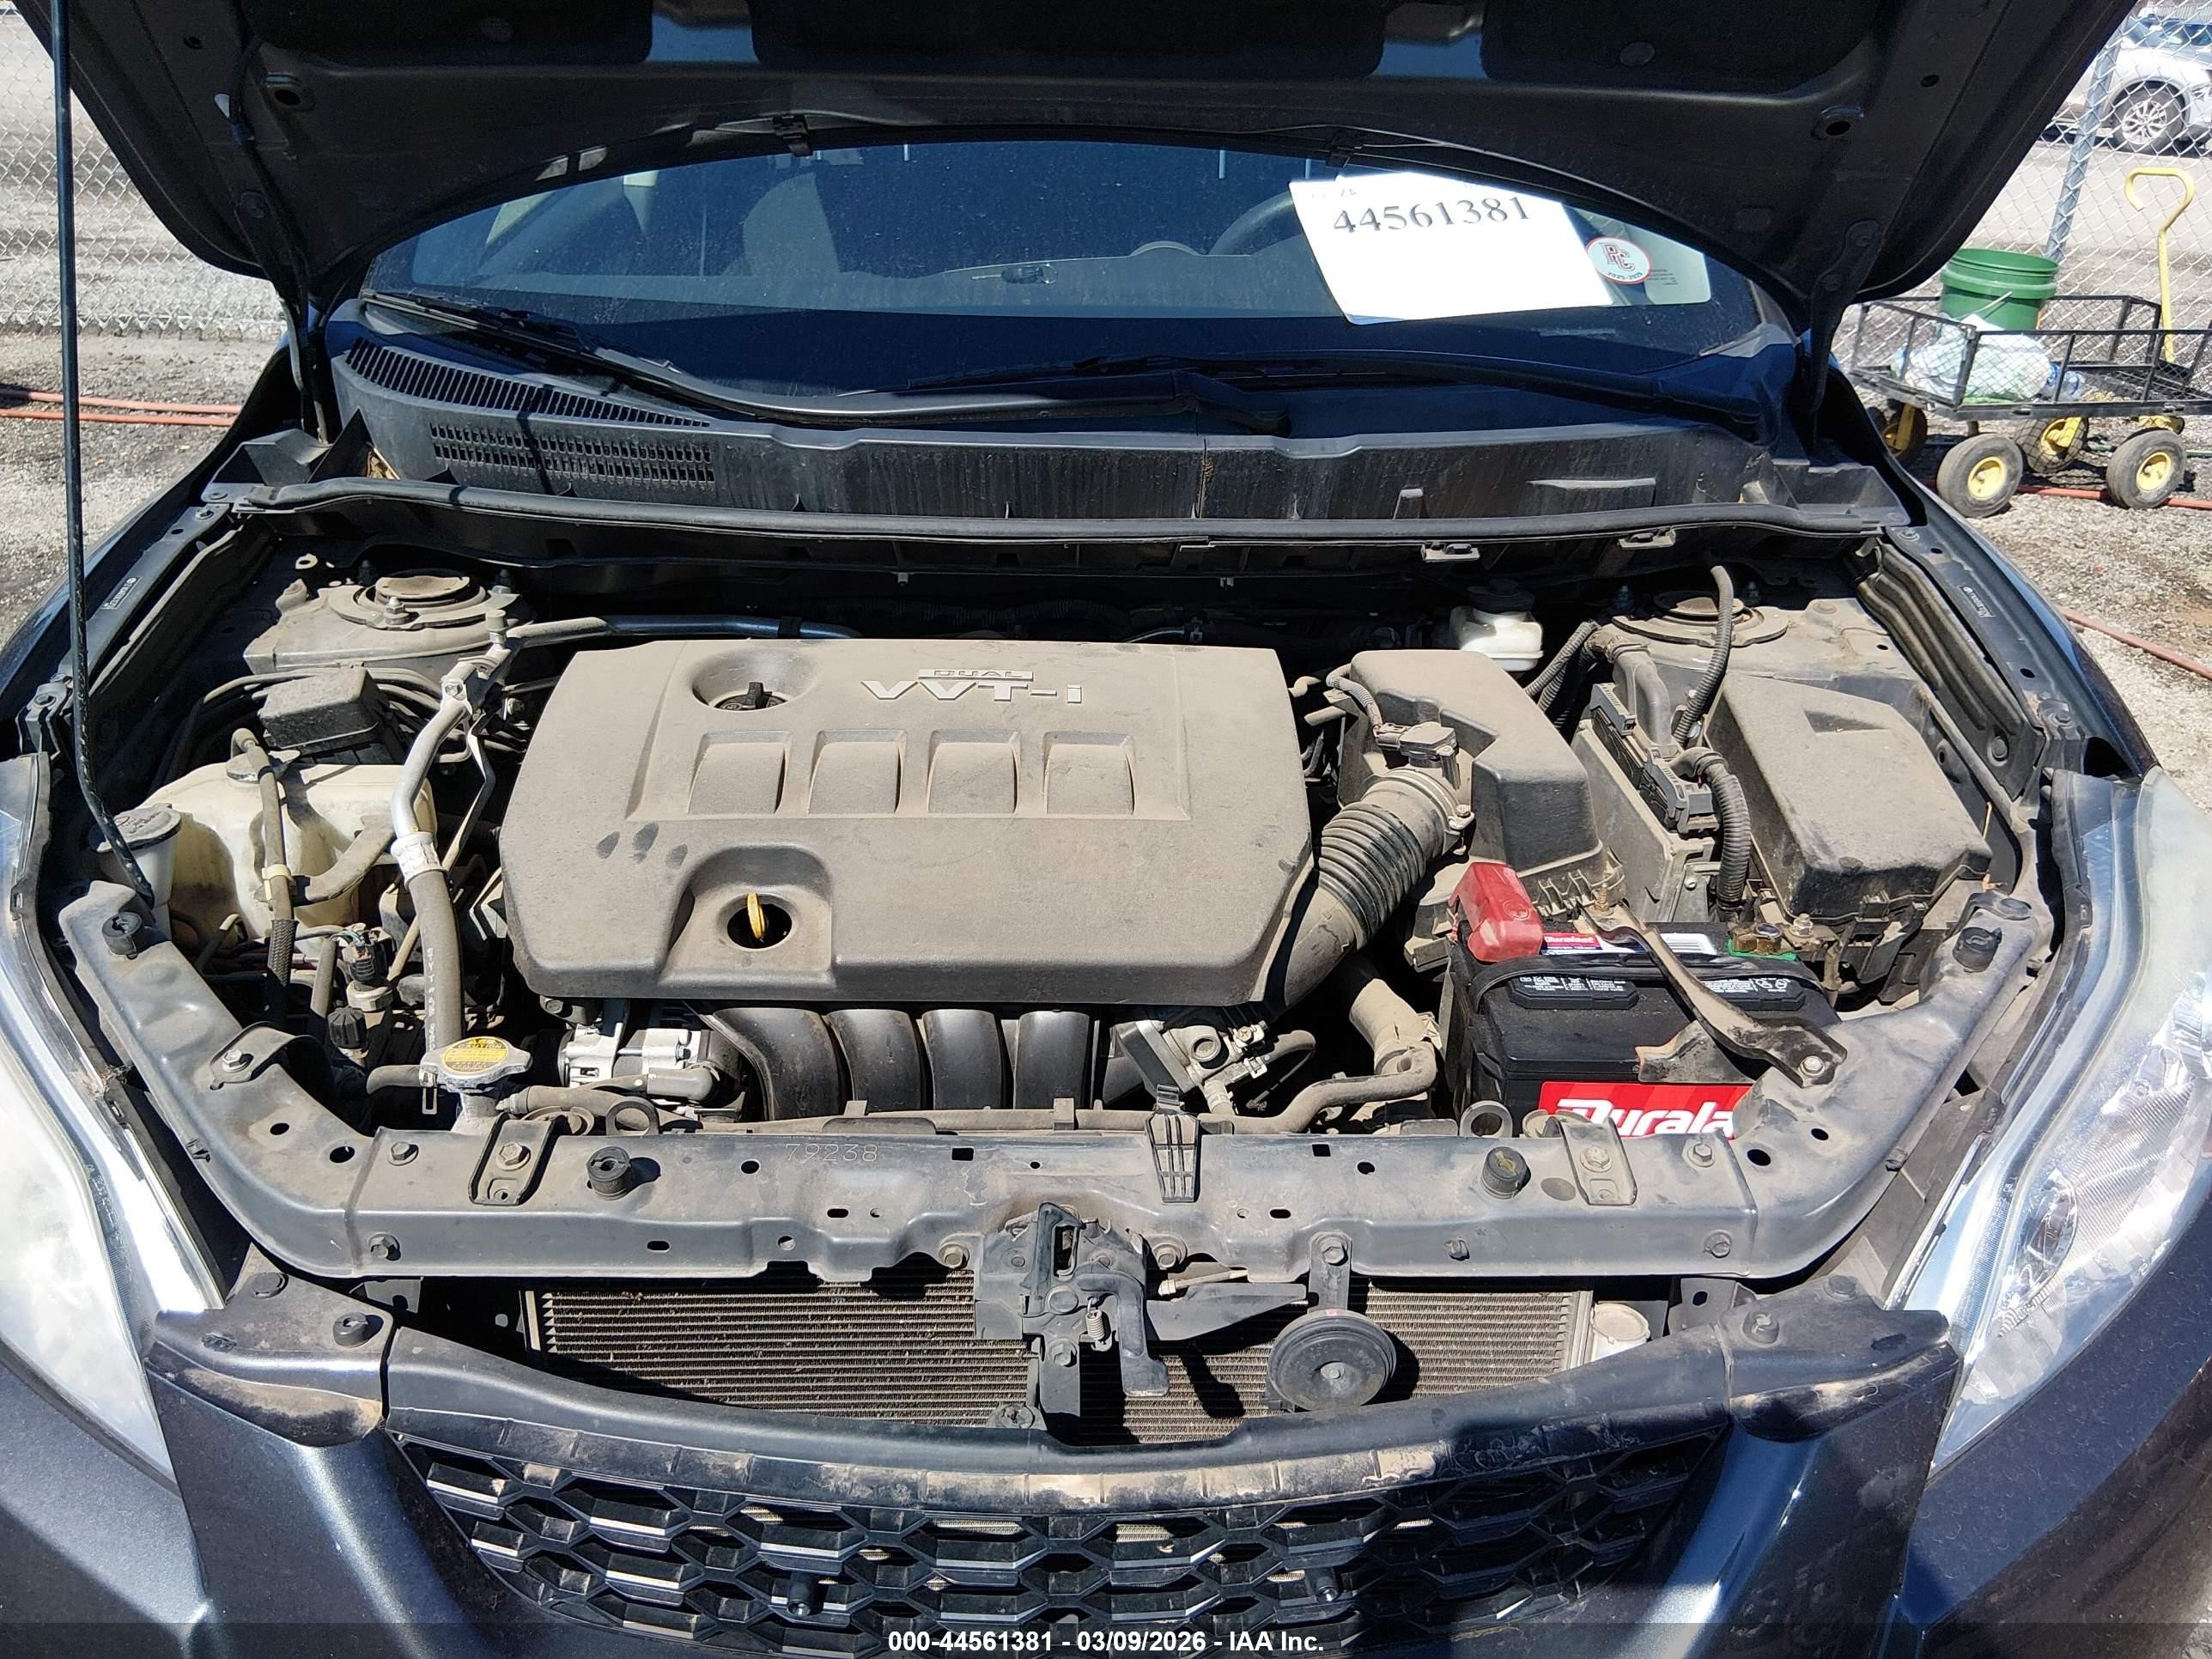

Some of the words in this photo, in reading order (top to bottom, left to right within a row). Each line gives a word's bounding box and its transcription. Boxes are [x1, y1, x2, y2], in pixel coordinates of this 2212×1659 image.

[1334, 197, 1529, 234] 44561381
[933, 669, 1024, 678] DUAL
[860, 680, 1083, 704] VVT-i
[785, 1143, 878, 1164] 79238
